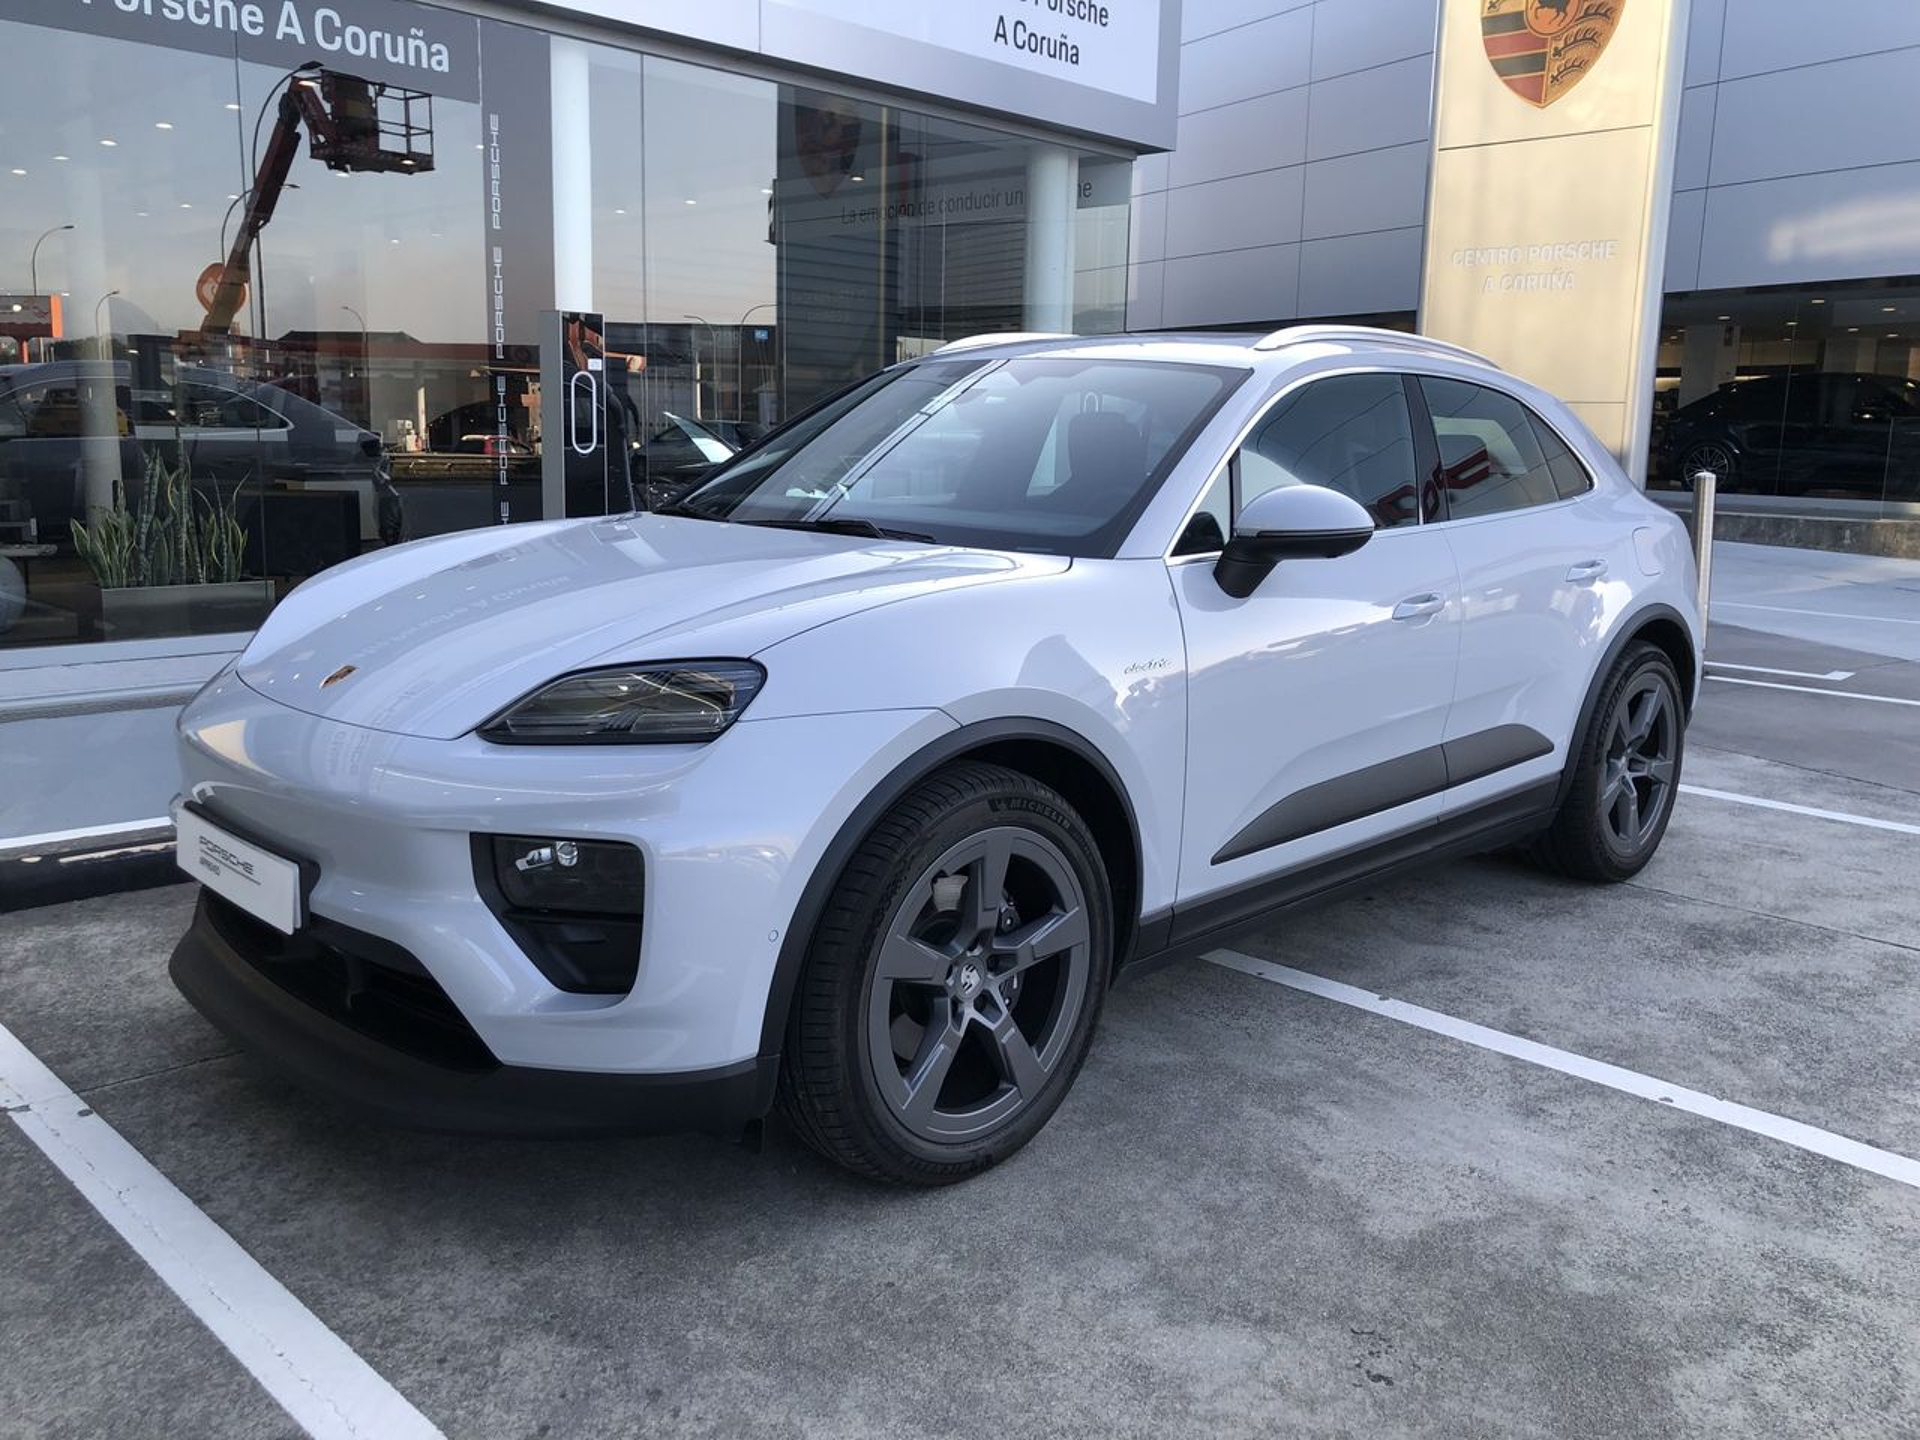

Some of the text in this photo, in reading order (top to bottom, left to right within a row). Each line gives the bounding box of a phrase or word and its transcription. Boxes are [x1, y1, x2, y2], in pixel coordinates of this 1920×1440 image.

[1034, 0, 1109, 27] orsche
[275, 1, 306, 45] A
[314, 8, 449, 73] Coruña
[993, 15, 1079, 66] A Coruña
[489, 113, 502, 229] PORSCHE
[938, 189, 1000, 214] conducir
[1007, 189, 1024, 206] un
[1452, 239, 1618, 267] CENTRO PORSCHE
[1483, 266, 1576, 293] A CORUÑA
[493, 247, 504, 360] PORSCHE
[497, 376, 508, 485] PORSCHE
[199, 836, 254, 875] PORSCHE
